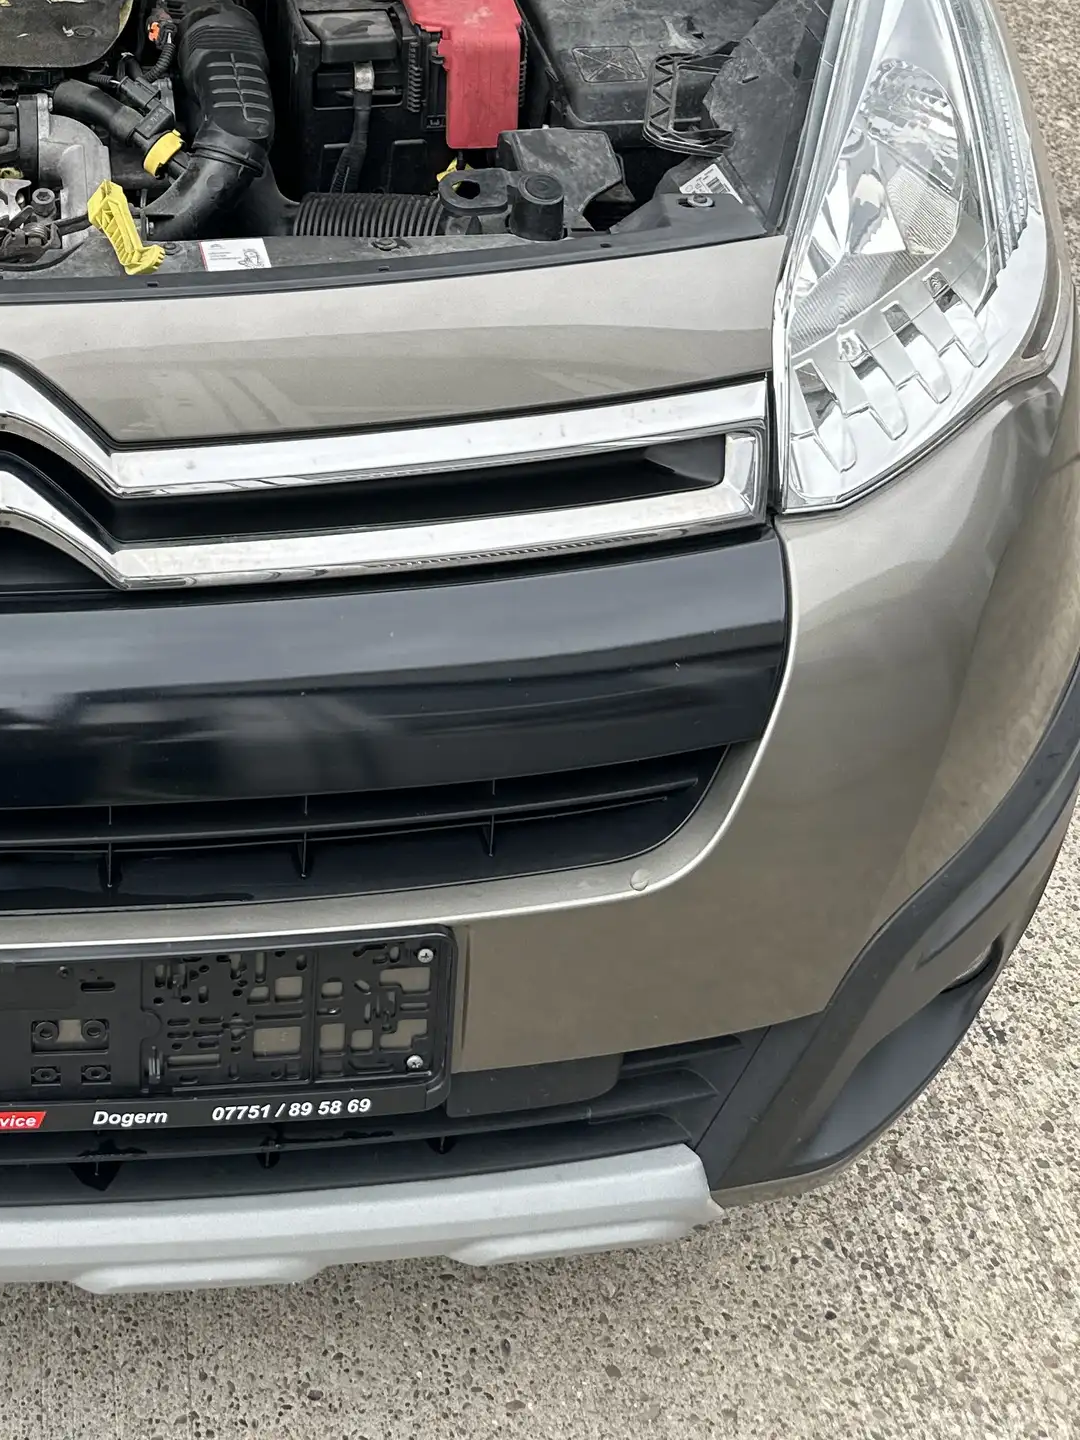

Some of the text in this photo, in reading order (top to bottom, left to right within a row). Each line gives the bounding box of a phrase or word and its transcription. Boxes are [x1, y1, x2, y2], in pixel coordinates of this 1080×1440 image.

[92, 1110, 168, 1127] Dogern
[212, 1098, 372, 1121] 07751 / 89 58 69
